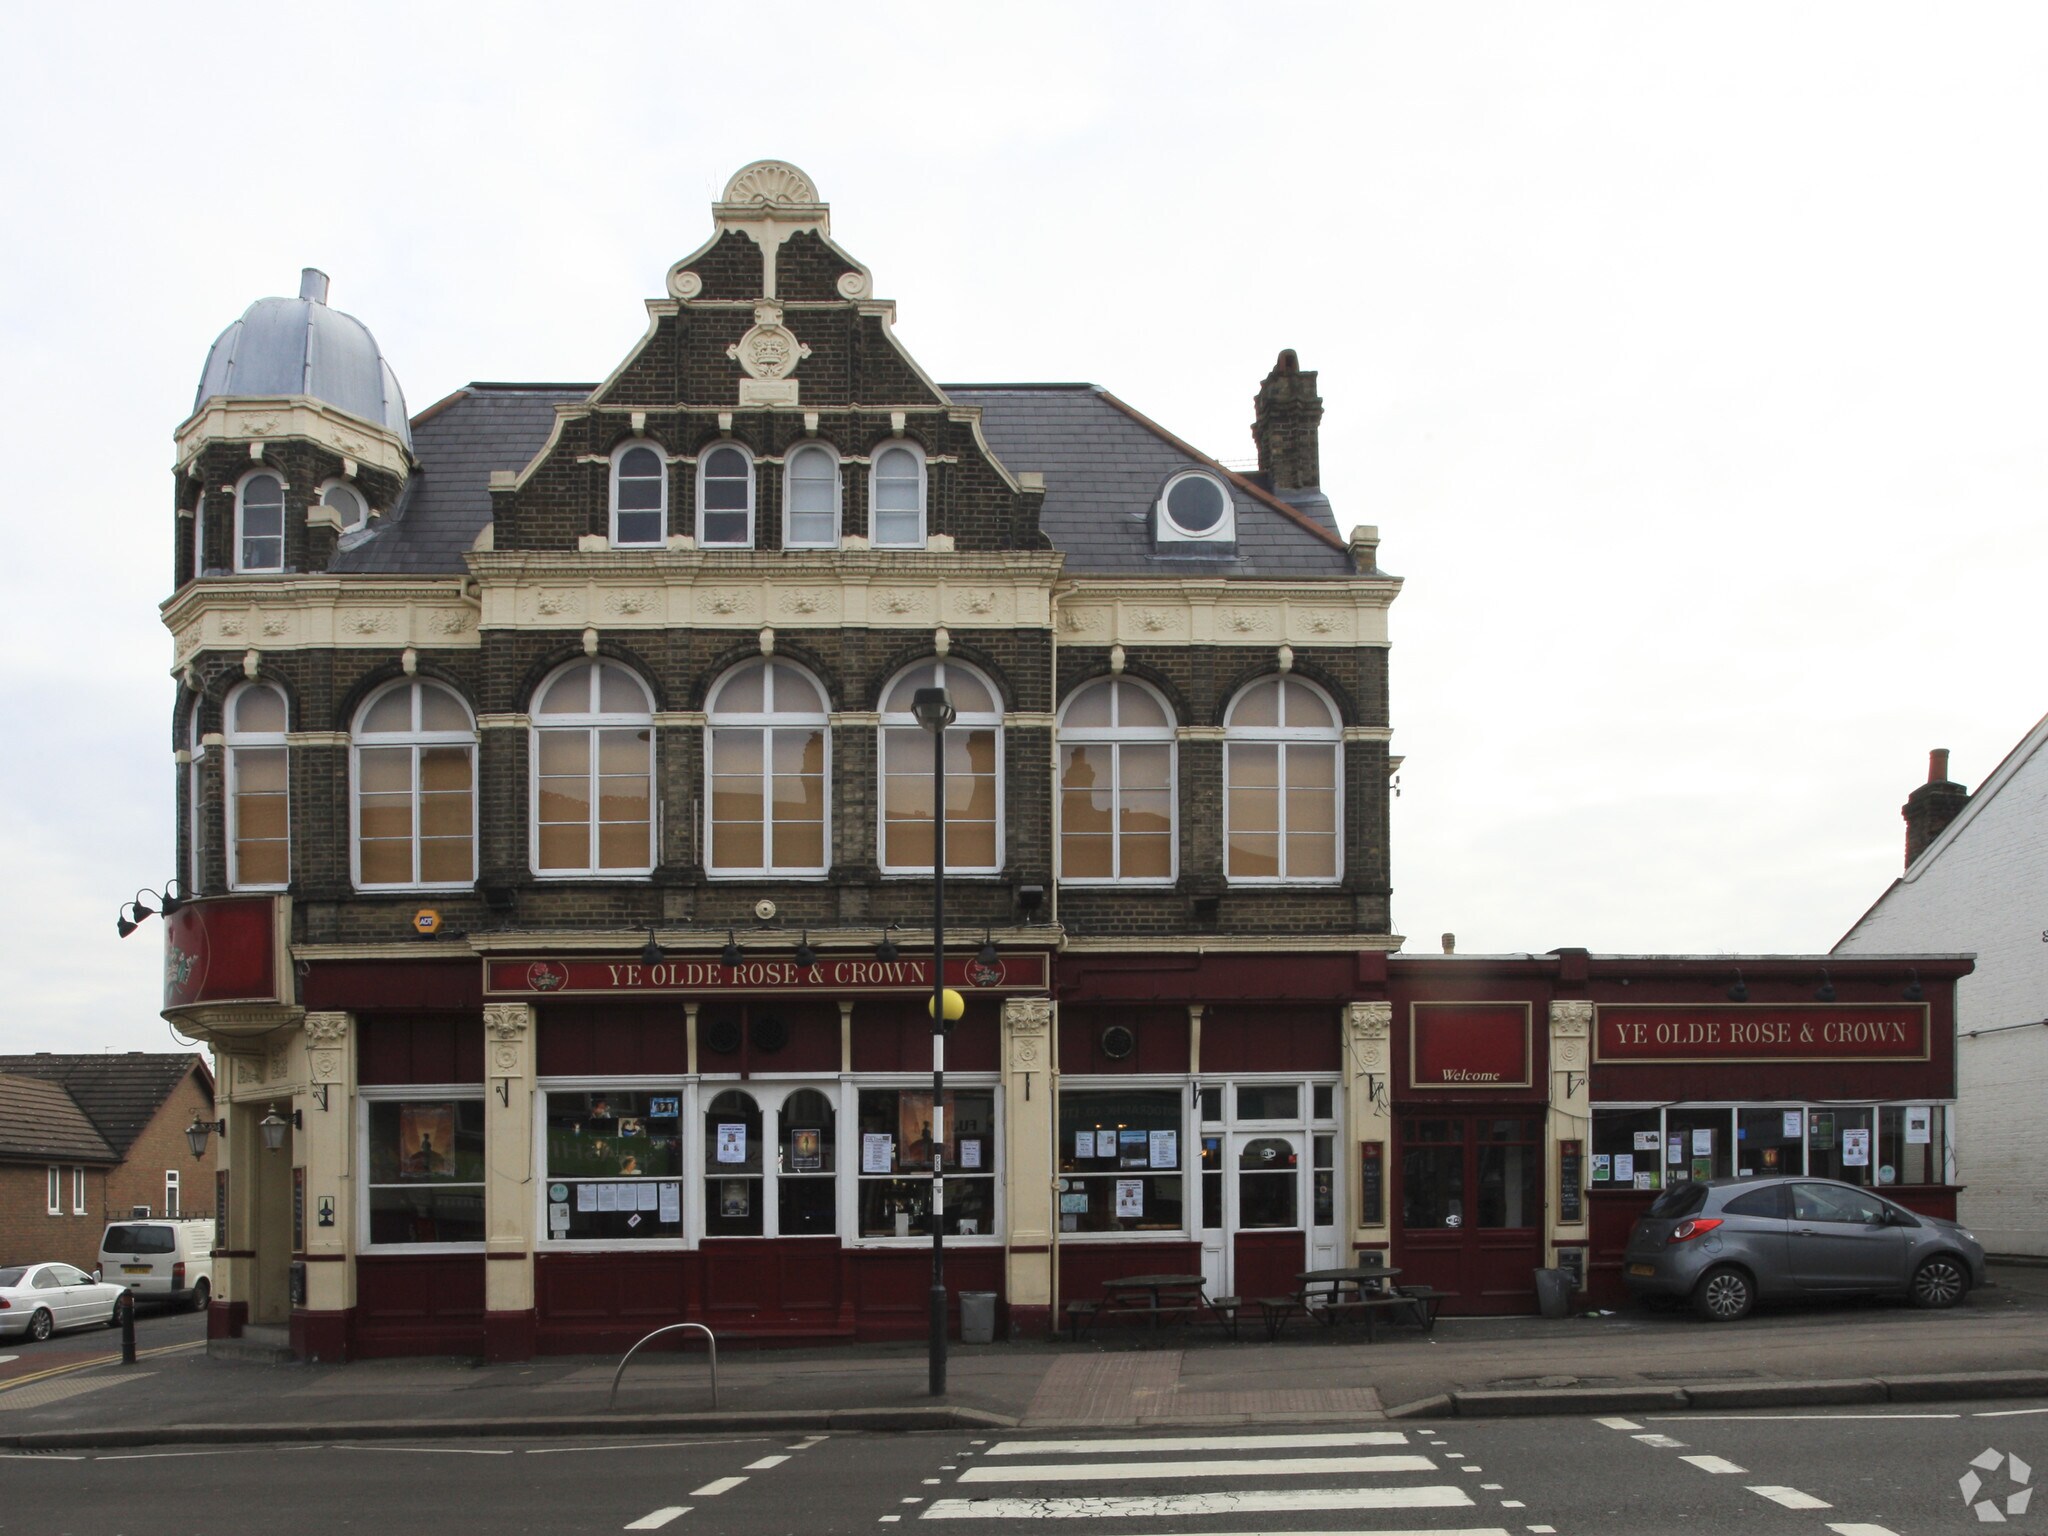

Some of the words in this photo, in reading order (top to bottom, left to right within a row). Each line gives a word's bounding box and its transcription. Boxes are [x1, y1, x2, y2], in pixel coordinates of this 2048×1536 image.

[419, 917, 433, 925] ADT
[608, 964, 642, 985] YE
[651, 964, 721, 985] OLDE
[732, 963, 798, 985] ROSE
[808, 962, 824, 983] &
[834, 962, 925, 983] CROWN
[1616, 1023, 1648, 1043] YE
[1656, 1023, 1721, 1043] OLDE
[1729, 1022, 1791, 1043] ROSE
[1800, 1022, 1814, 1042] &
[1823, 1022, 1906, 1042] CROWN
[1442, 1068, 1500, 1081] Welcome
